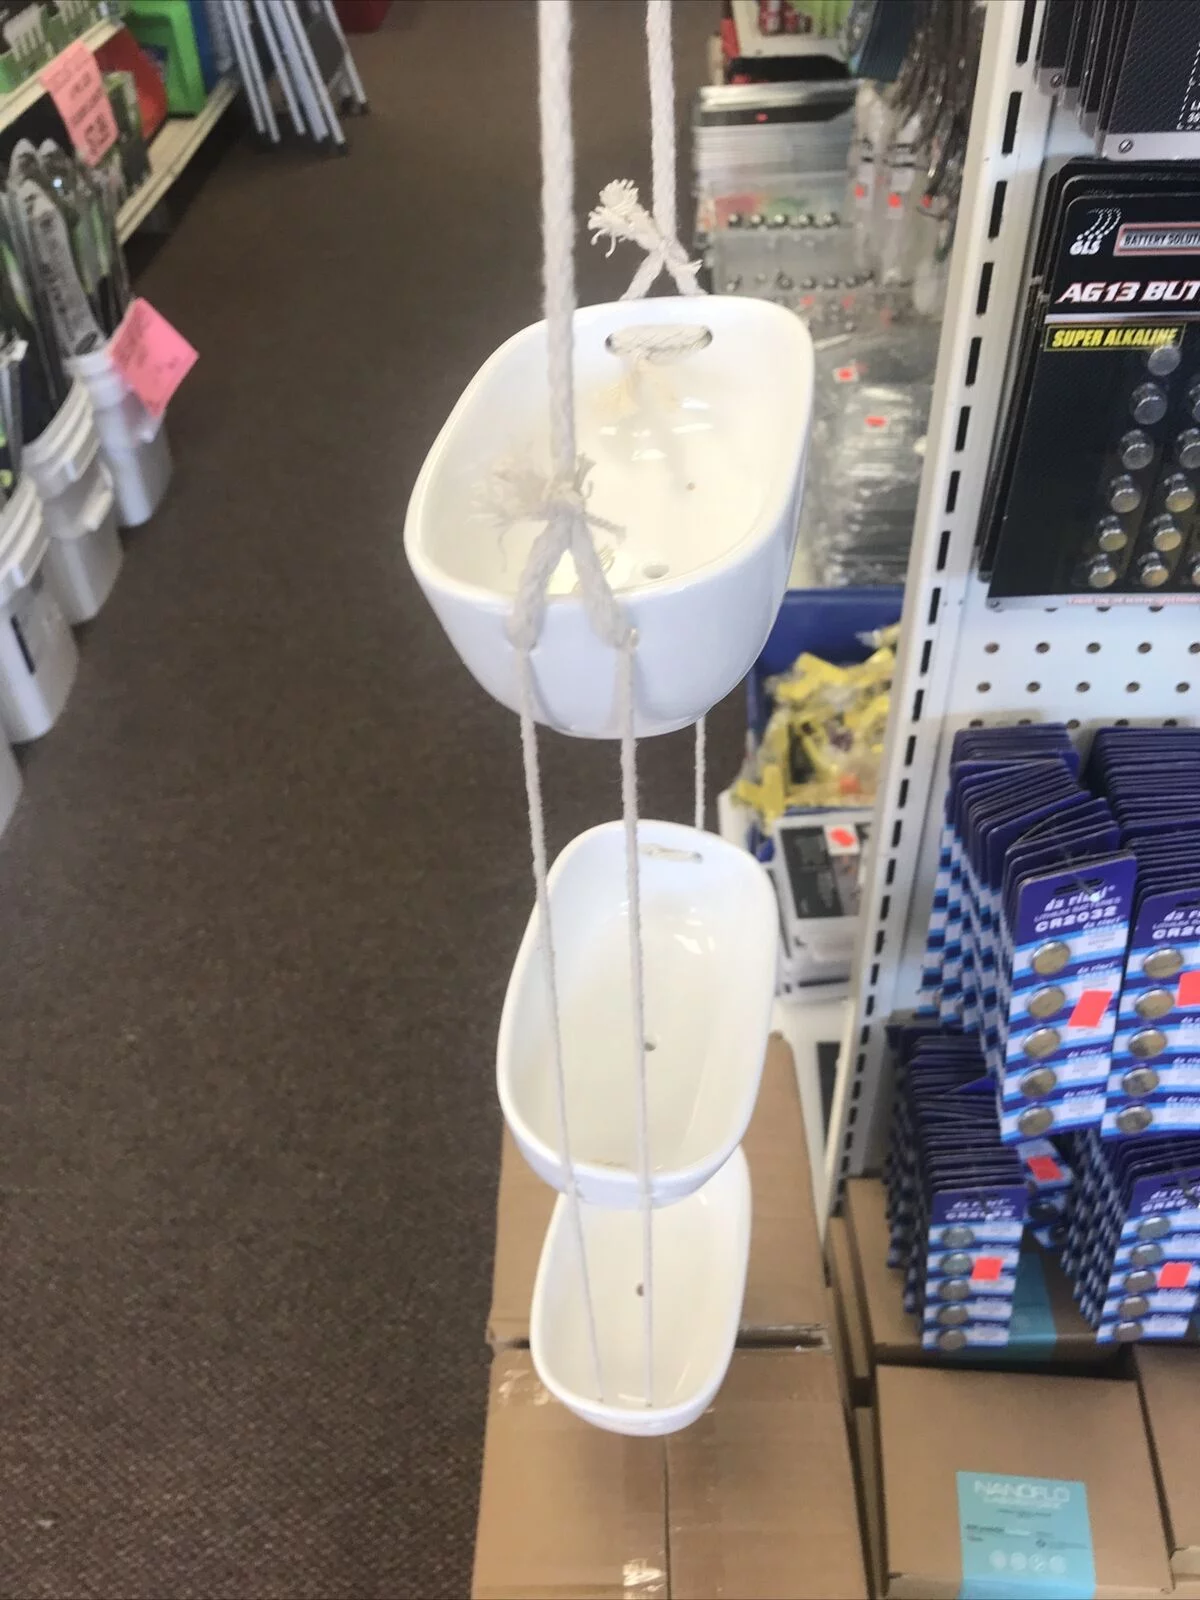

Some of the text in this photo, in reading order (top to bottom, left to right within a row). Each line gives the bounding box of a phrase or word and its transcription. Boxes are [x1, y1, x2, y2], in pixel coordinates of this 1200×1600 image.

[1055, 281, 1140, 303] AG13
[1052, 328, 1178, 347] SUPER ALKALINE
[1035, 905, 1117, 932] CR2032
